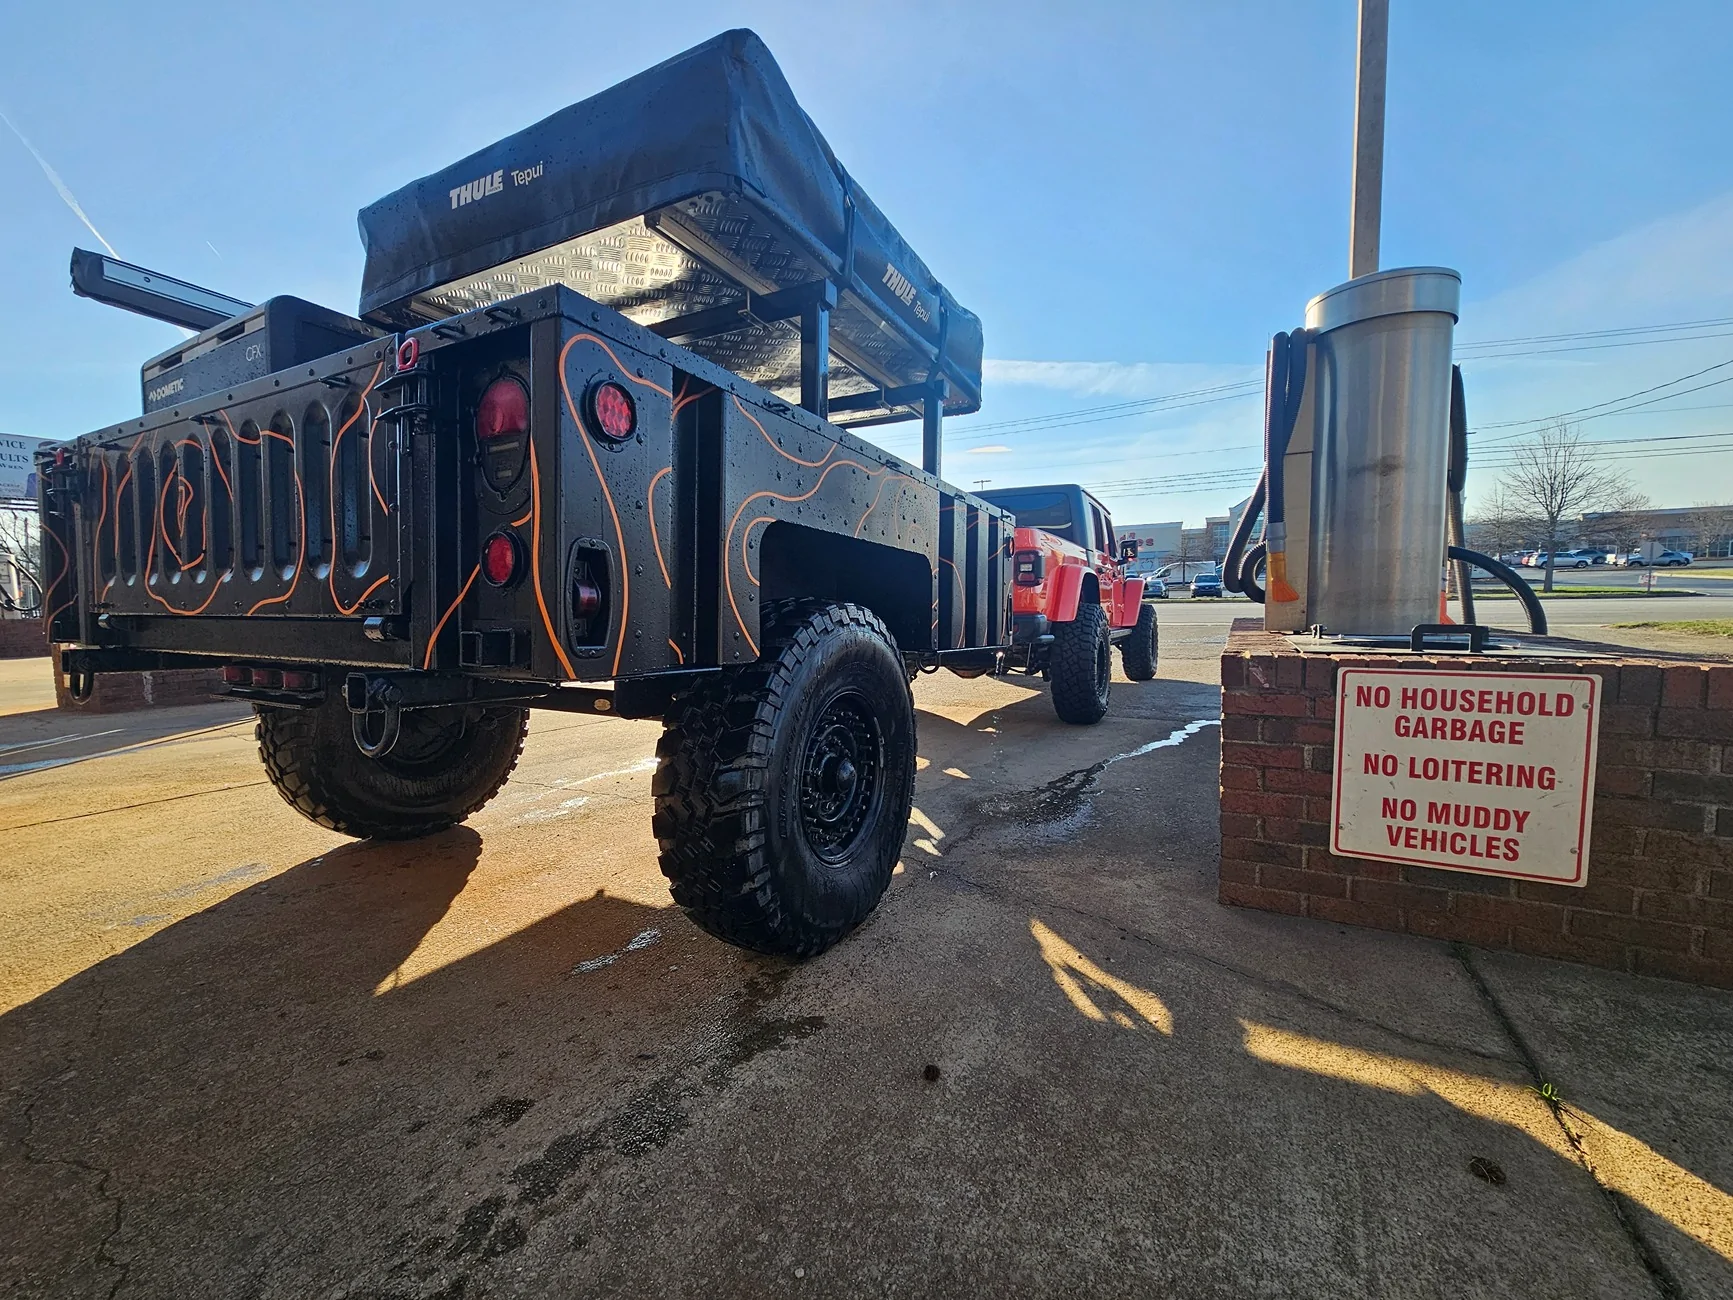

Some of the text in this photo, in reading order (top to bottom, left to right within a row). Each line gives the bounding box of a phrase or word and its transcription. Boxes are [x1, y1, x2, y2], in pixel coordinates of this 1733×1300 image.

[449, 160, 544, 210] THULE Tepui
[881, 262, 931, 323] THULE Tepui
[245, 343, 262, 362] CFX
[156, 378, 184, 401] DOMETIC
[1356, 685, 1575, 718] NO HOUSEHOLD
[1394, 715, 1525, 746] GARBAGE
[1363, 753, 1557, 791] NO LOITERING
[1381, 797, 1531, 834] NO MUDDY
[1386, 824, 1520, 862] VEHICLES
